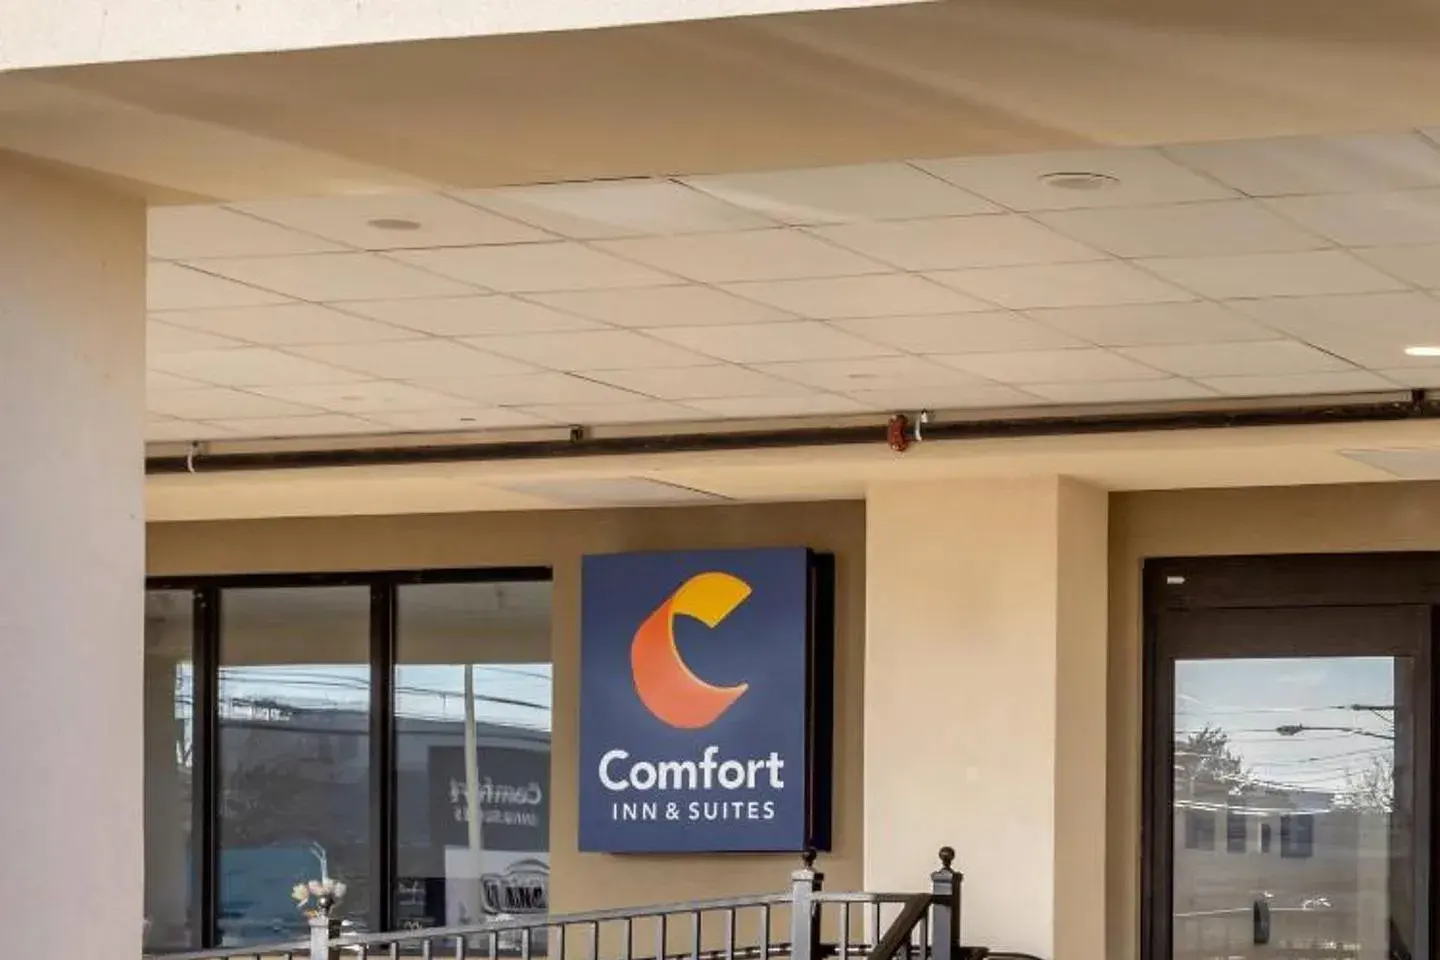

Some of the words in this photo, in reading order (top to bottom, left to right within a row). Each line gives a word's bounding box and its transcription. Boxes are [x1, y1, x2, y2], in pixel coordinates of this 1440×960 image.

[598, 745, 785, 791] Comfort
[612, 802, 657, 820] INN
[665, 802, 680, 820] &
[688, 801, 775, 820] SUITES
